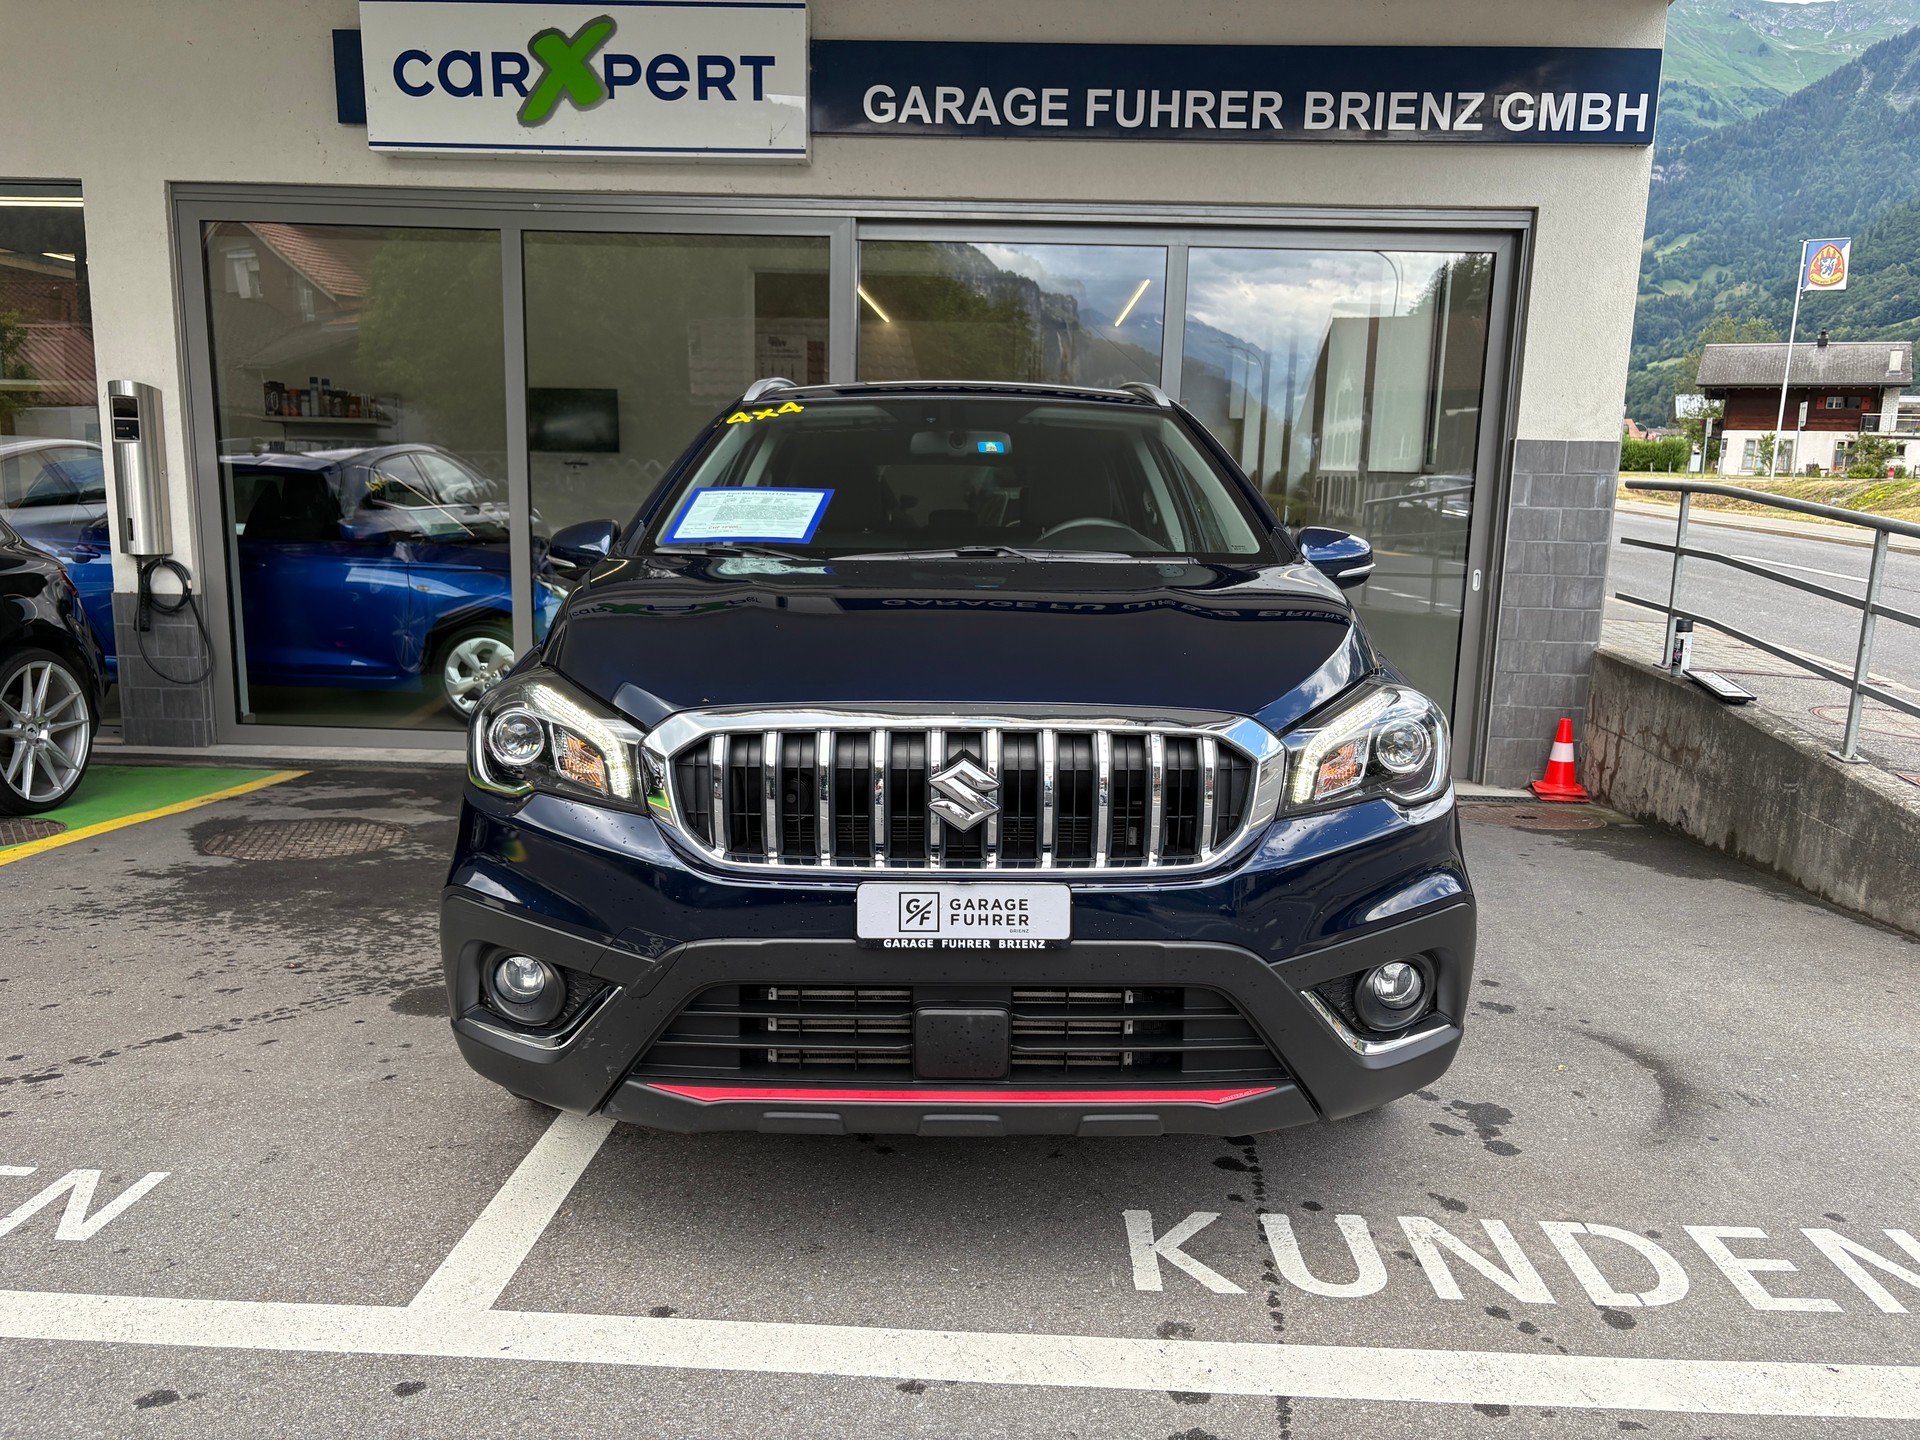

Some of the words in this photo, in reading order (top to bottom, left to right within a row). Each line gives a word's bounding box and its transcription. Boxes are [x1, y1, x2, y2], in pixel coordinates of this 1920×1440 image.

[863, 85, 1068, 126] GARAGE
[1086, 89, 1281, 130] FUHRER
[1304, 91, 1484, 131] BRIENZ
[1500, 92, 1647, 133] GMBH
[726, 402, 804, 424] 4x4
[949, 898, 1029, 911] GARAGE
[950, 914, 1030, 926] FUHRER
[883, 939, 934, 948] GARAGE
[942, 939, 991, 948] FUHRER
[998, 940, 1046, 949] BRIENZ
